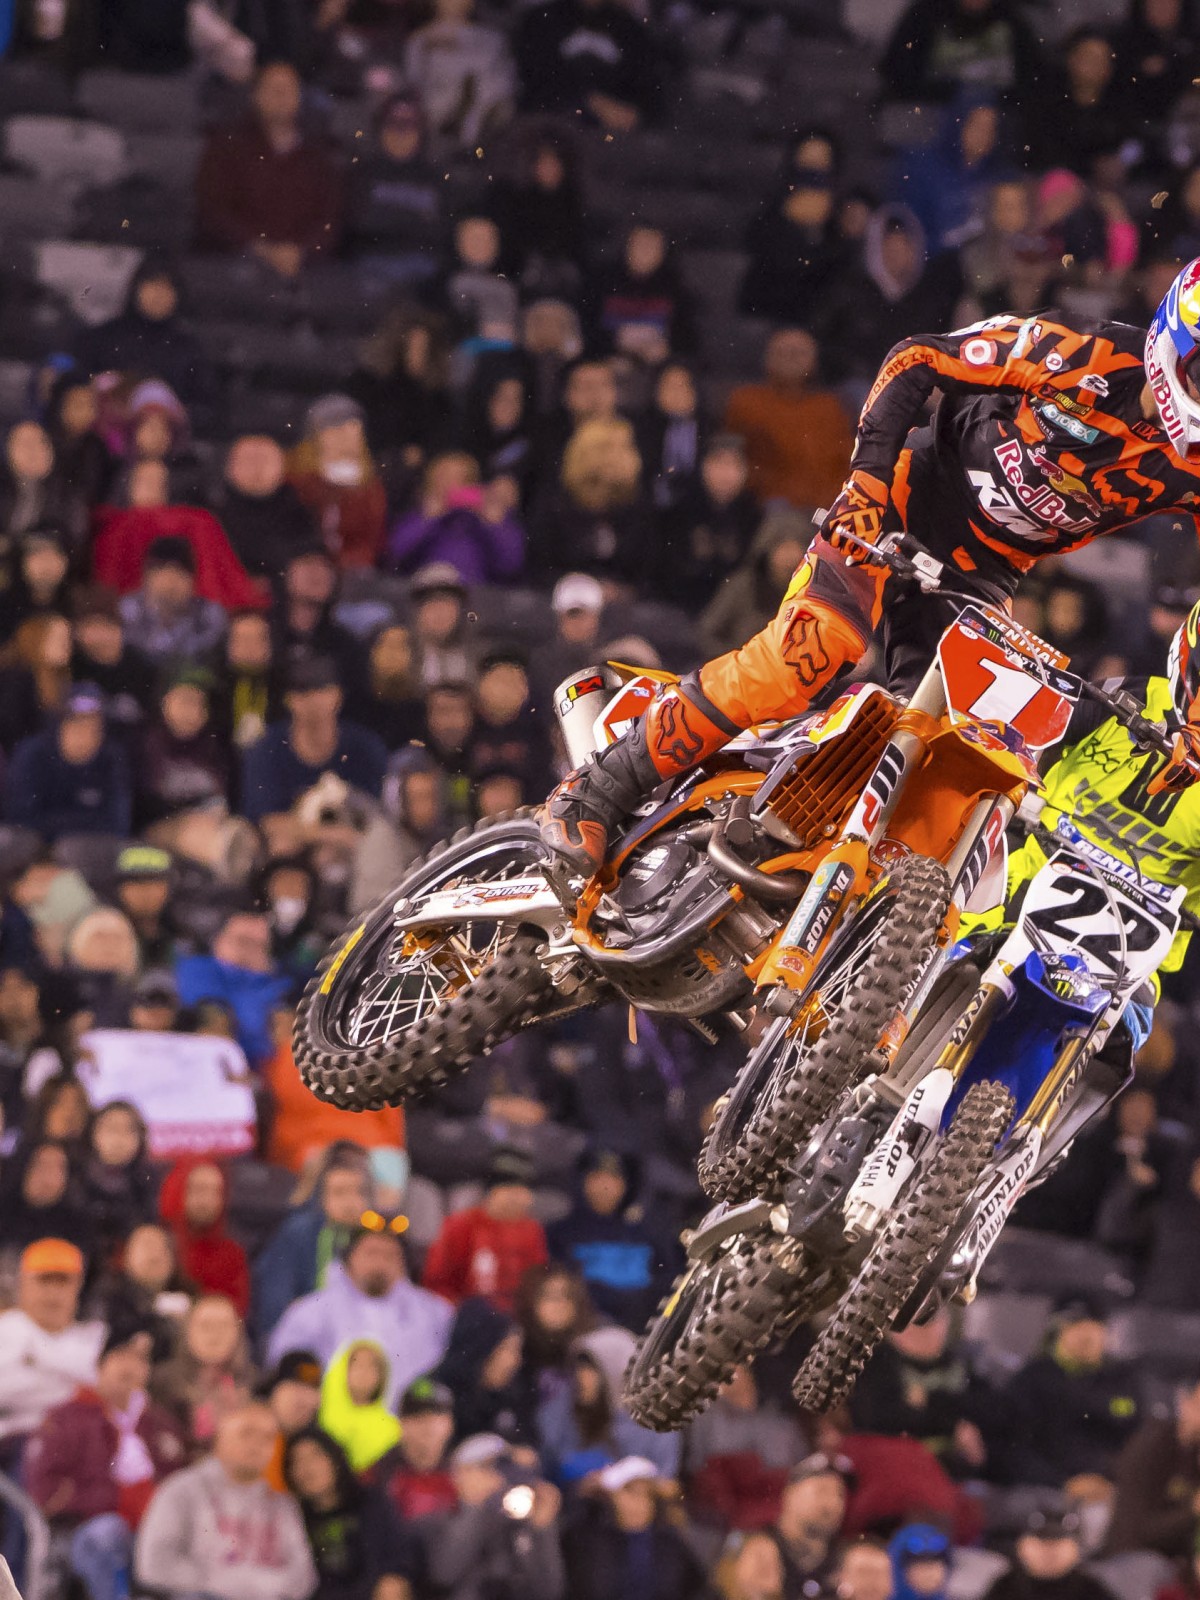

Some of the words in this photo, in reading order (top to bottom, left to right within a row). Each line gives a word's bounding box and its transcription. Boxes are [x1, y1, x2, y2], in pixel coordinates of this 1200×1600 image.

[1153, 380, 1185, 441] Bull
[967, 469, 1056, 541] KTM
[993, 438, 1051, 507] Red
[1028, 492, 1100, 534] Bull
[967, 656, 1045, 724] 1
[1024, 874, 1160, 979] 22
[887, 1087, 925, 1180] DUOP
[977, 1210, 1008, 1260] AMAHA
